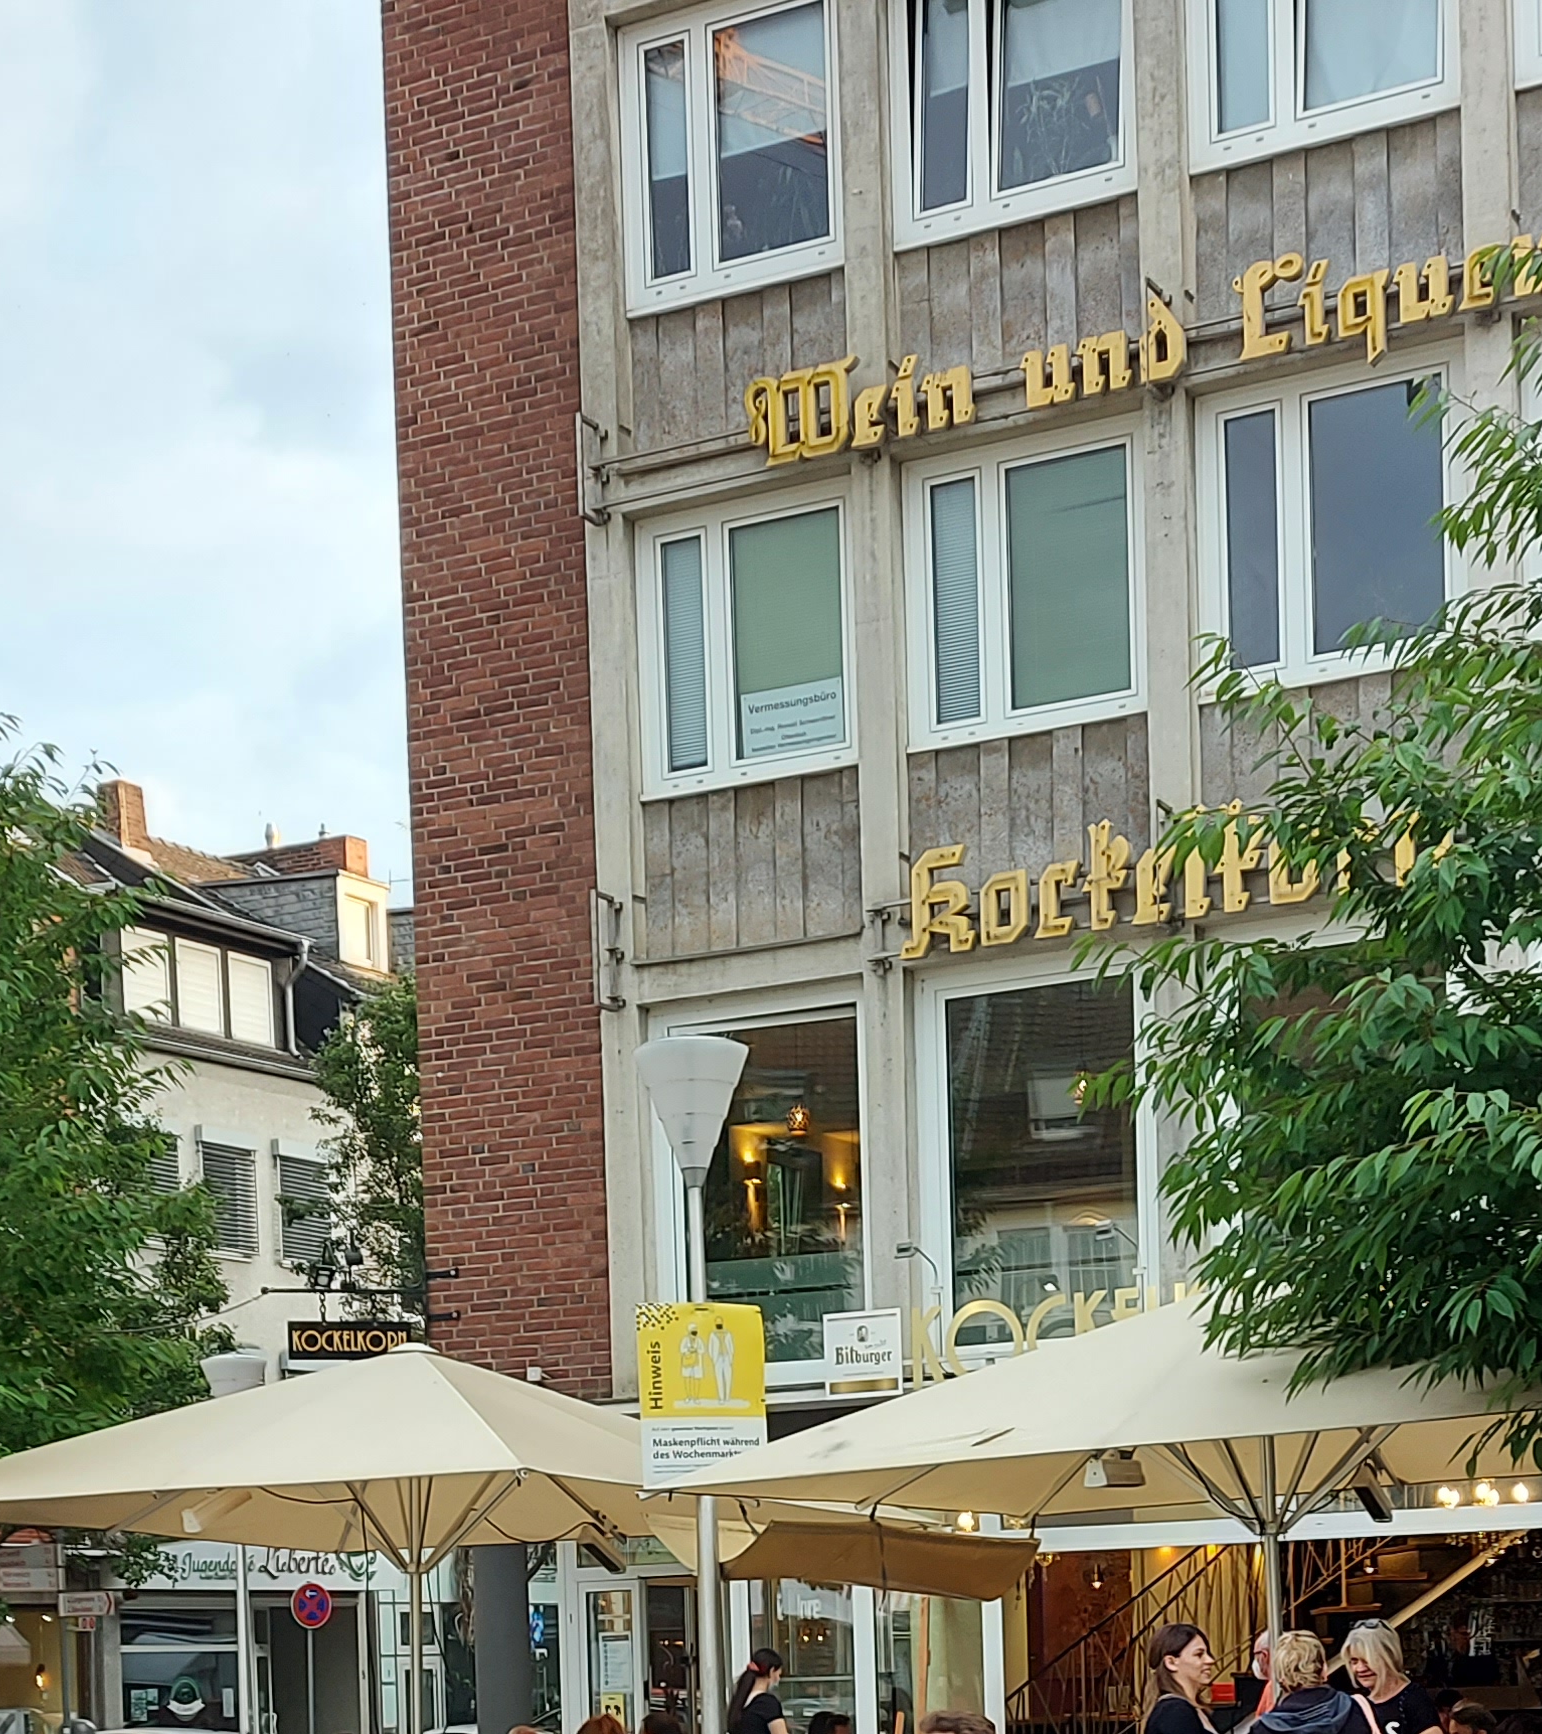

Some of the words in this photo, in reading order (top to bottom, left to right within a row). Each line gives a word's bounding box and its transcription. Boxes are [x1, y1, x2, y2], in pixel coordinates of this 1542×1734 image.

[744, 353, 976, 467] Wein
[1019, 297, 1188, 409] und
[747, 690, 838, 716] Vermessungsbüro
[834, 1346, 893, 1366] Bitburger
[646, 1341, 664, 1410] Hinweis
[652, 1437, 721, 1450] Maskenpflicht
[723, 1436, 760, 1447] während
[652, 1450, 670, 1460] des
